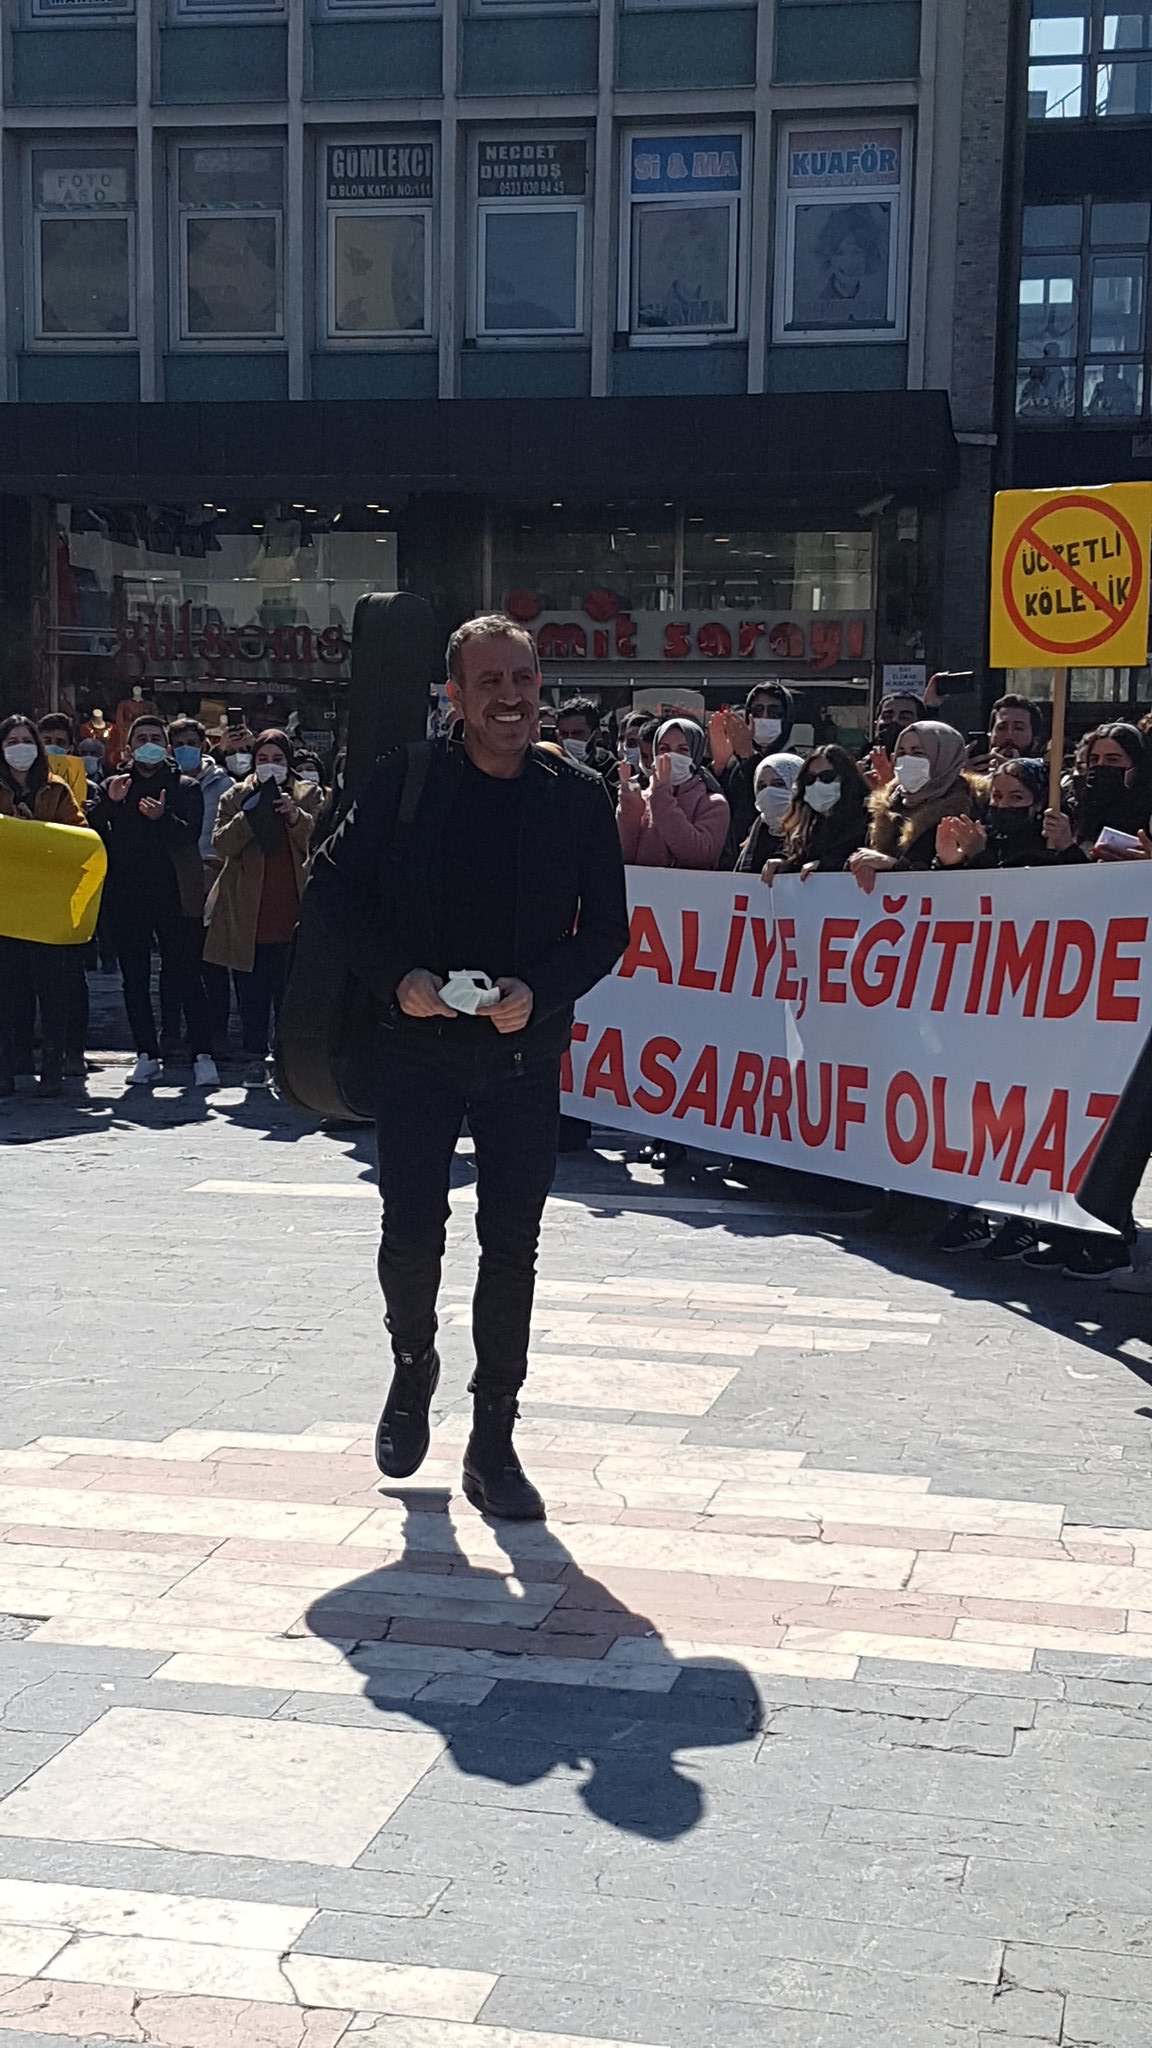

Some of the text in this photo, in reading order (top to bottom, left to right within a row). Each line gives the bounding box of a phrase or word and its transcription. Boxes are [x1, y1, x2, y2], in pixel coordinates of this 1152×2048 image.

[486, 145, 557, 160] NECDET
[792, 142, 897, 177] KUAFÖR
[480, 163, 561, 180] DURMUŞ
[691, 150, 739, 178] MA
[58, 174, 111, 188] FOTO
